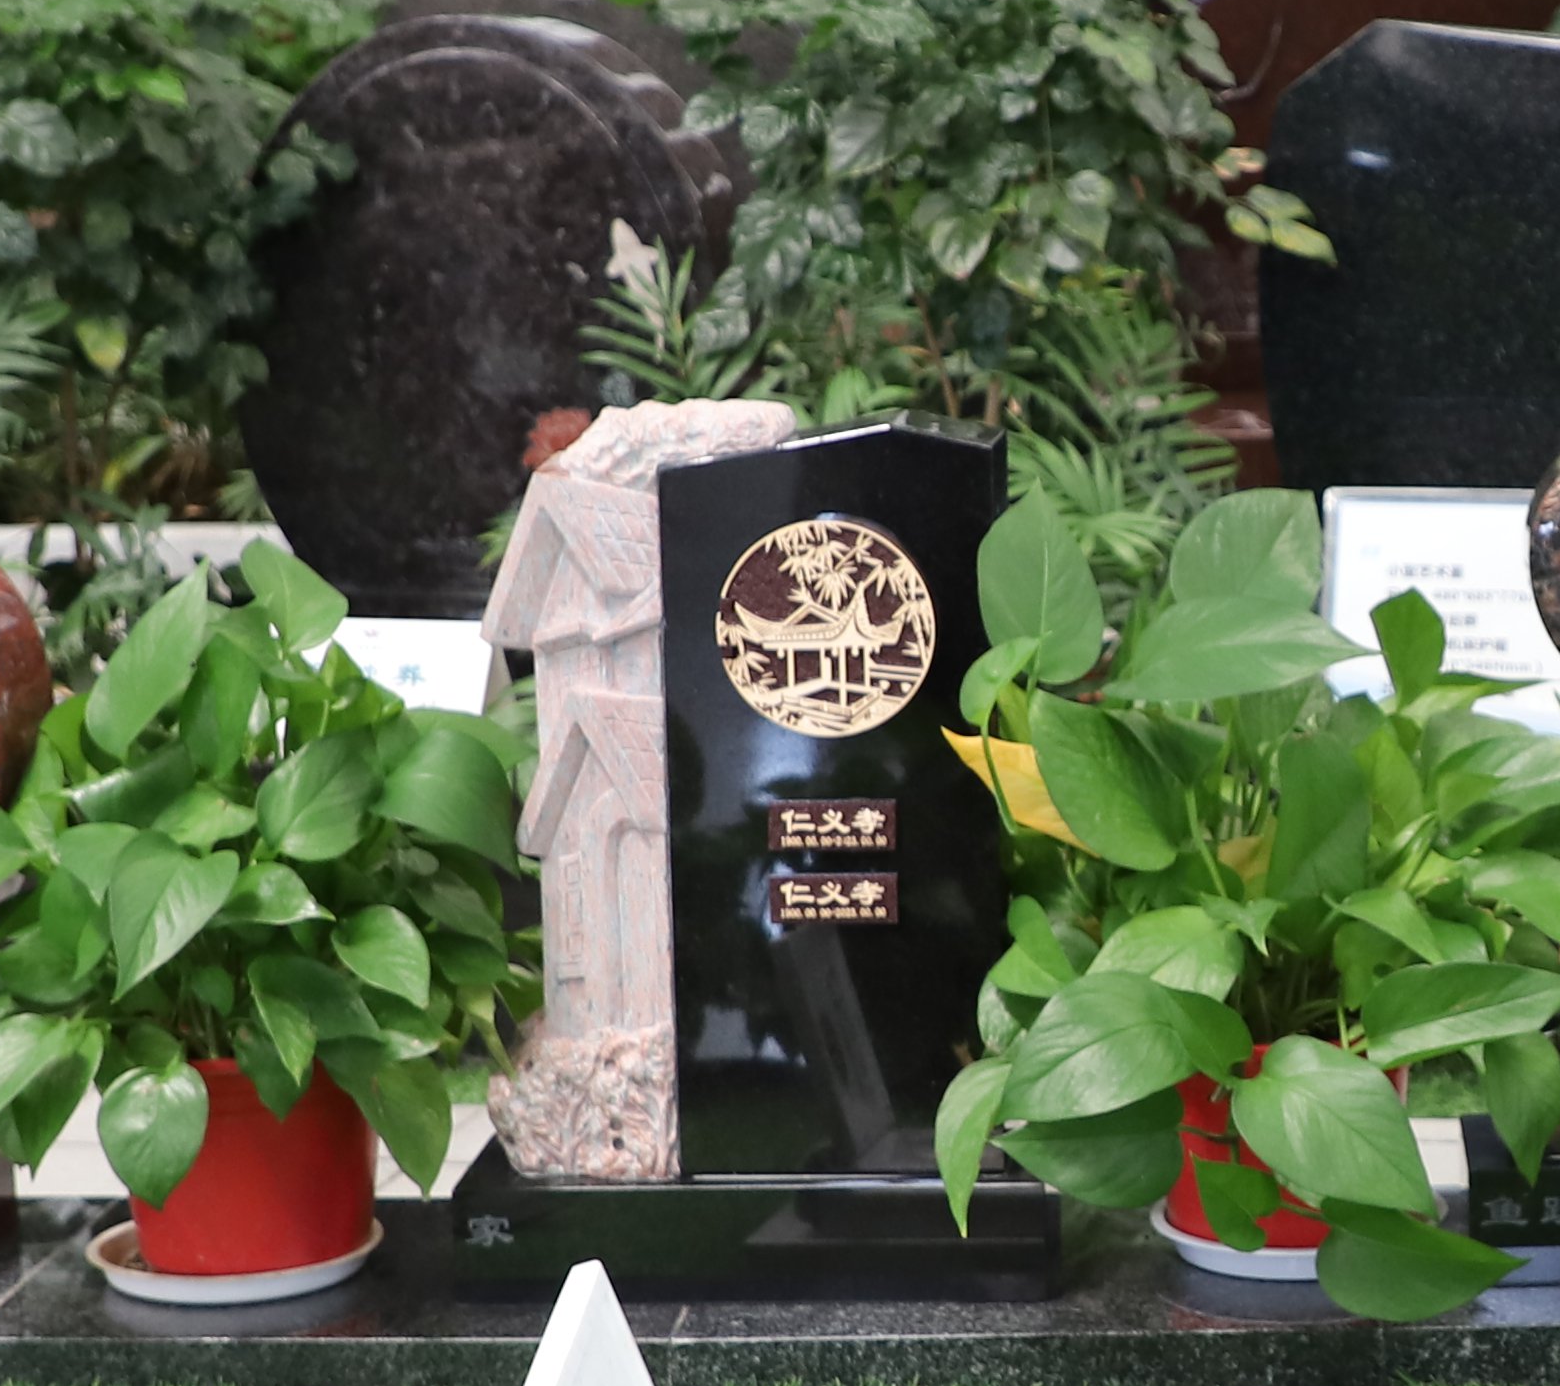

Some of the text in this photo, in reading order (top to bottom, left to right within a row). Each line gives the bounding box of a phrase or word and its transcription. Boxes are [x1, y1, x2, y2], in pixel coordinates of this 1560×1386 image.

[780, 807, 887, 835] 仁义孝
[779, 879, 886, 906] 仁义孝
[465, 1213, 515, 1248] 家
